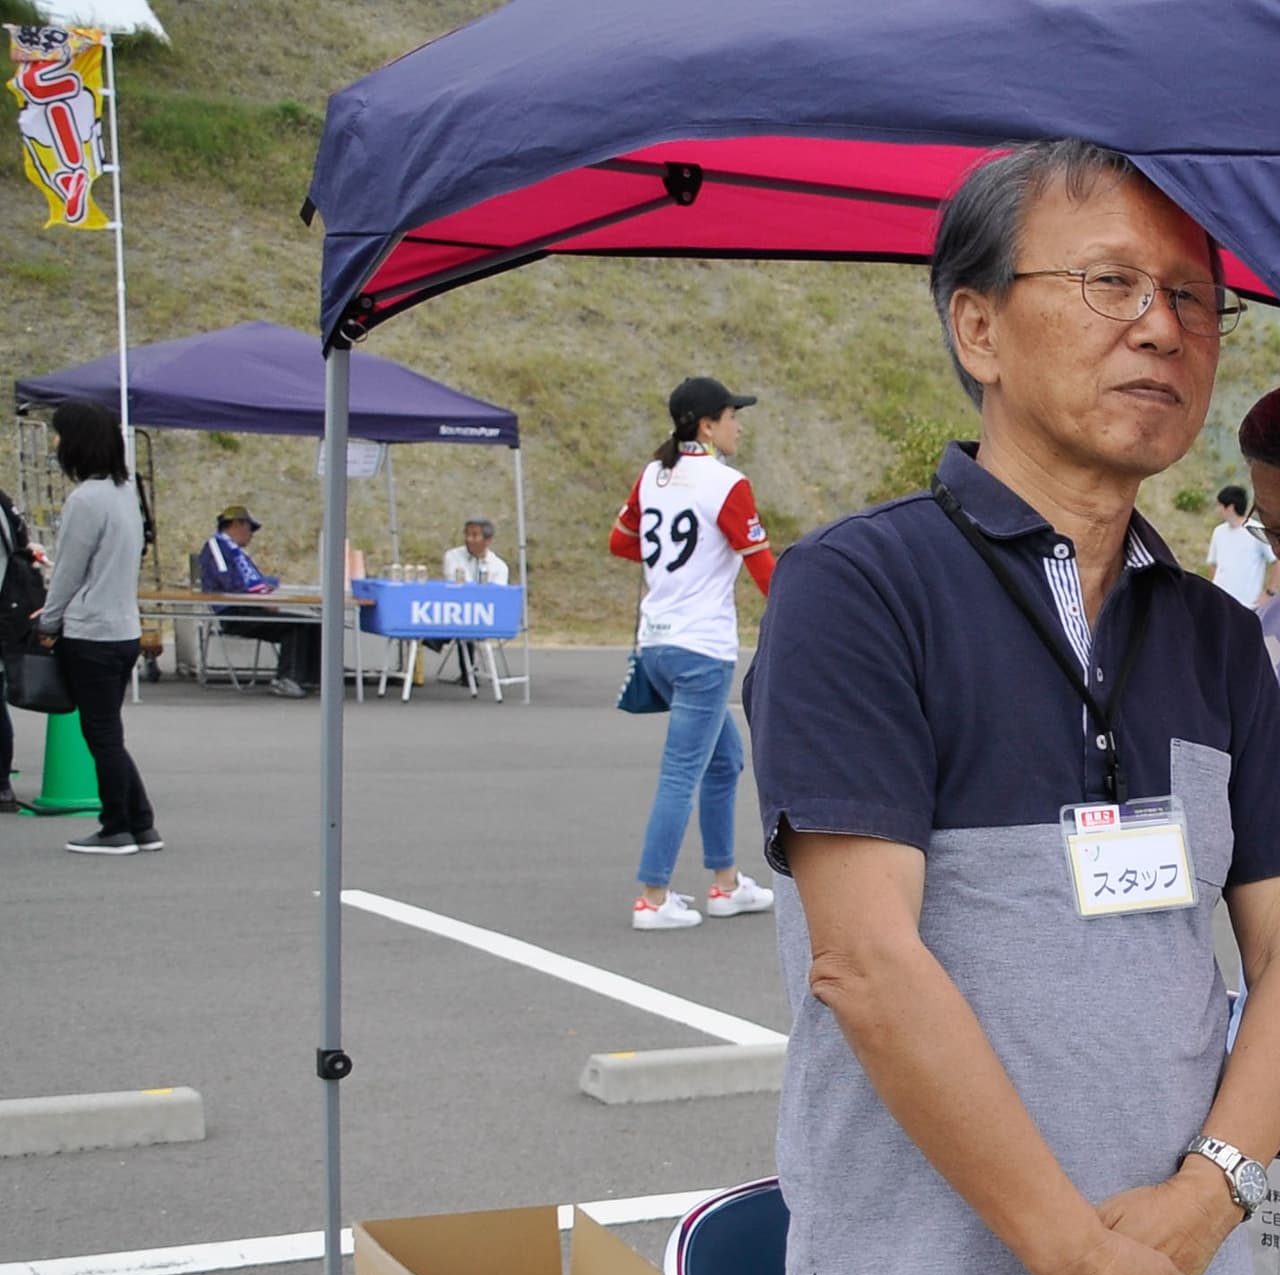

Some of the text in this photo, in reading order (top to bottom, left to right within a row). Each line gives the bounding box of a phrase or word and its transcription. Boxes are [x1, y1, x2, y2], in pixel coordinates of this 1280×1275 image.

[643, 507, 699, 574] 39
[411, 600, 495, 626] KIRIN
[1093, 864, 1179, 897] スタッフ
